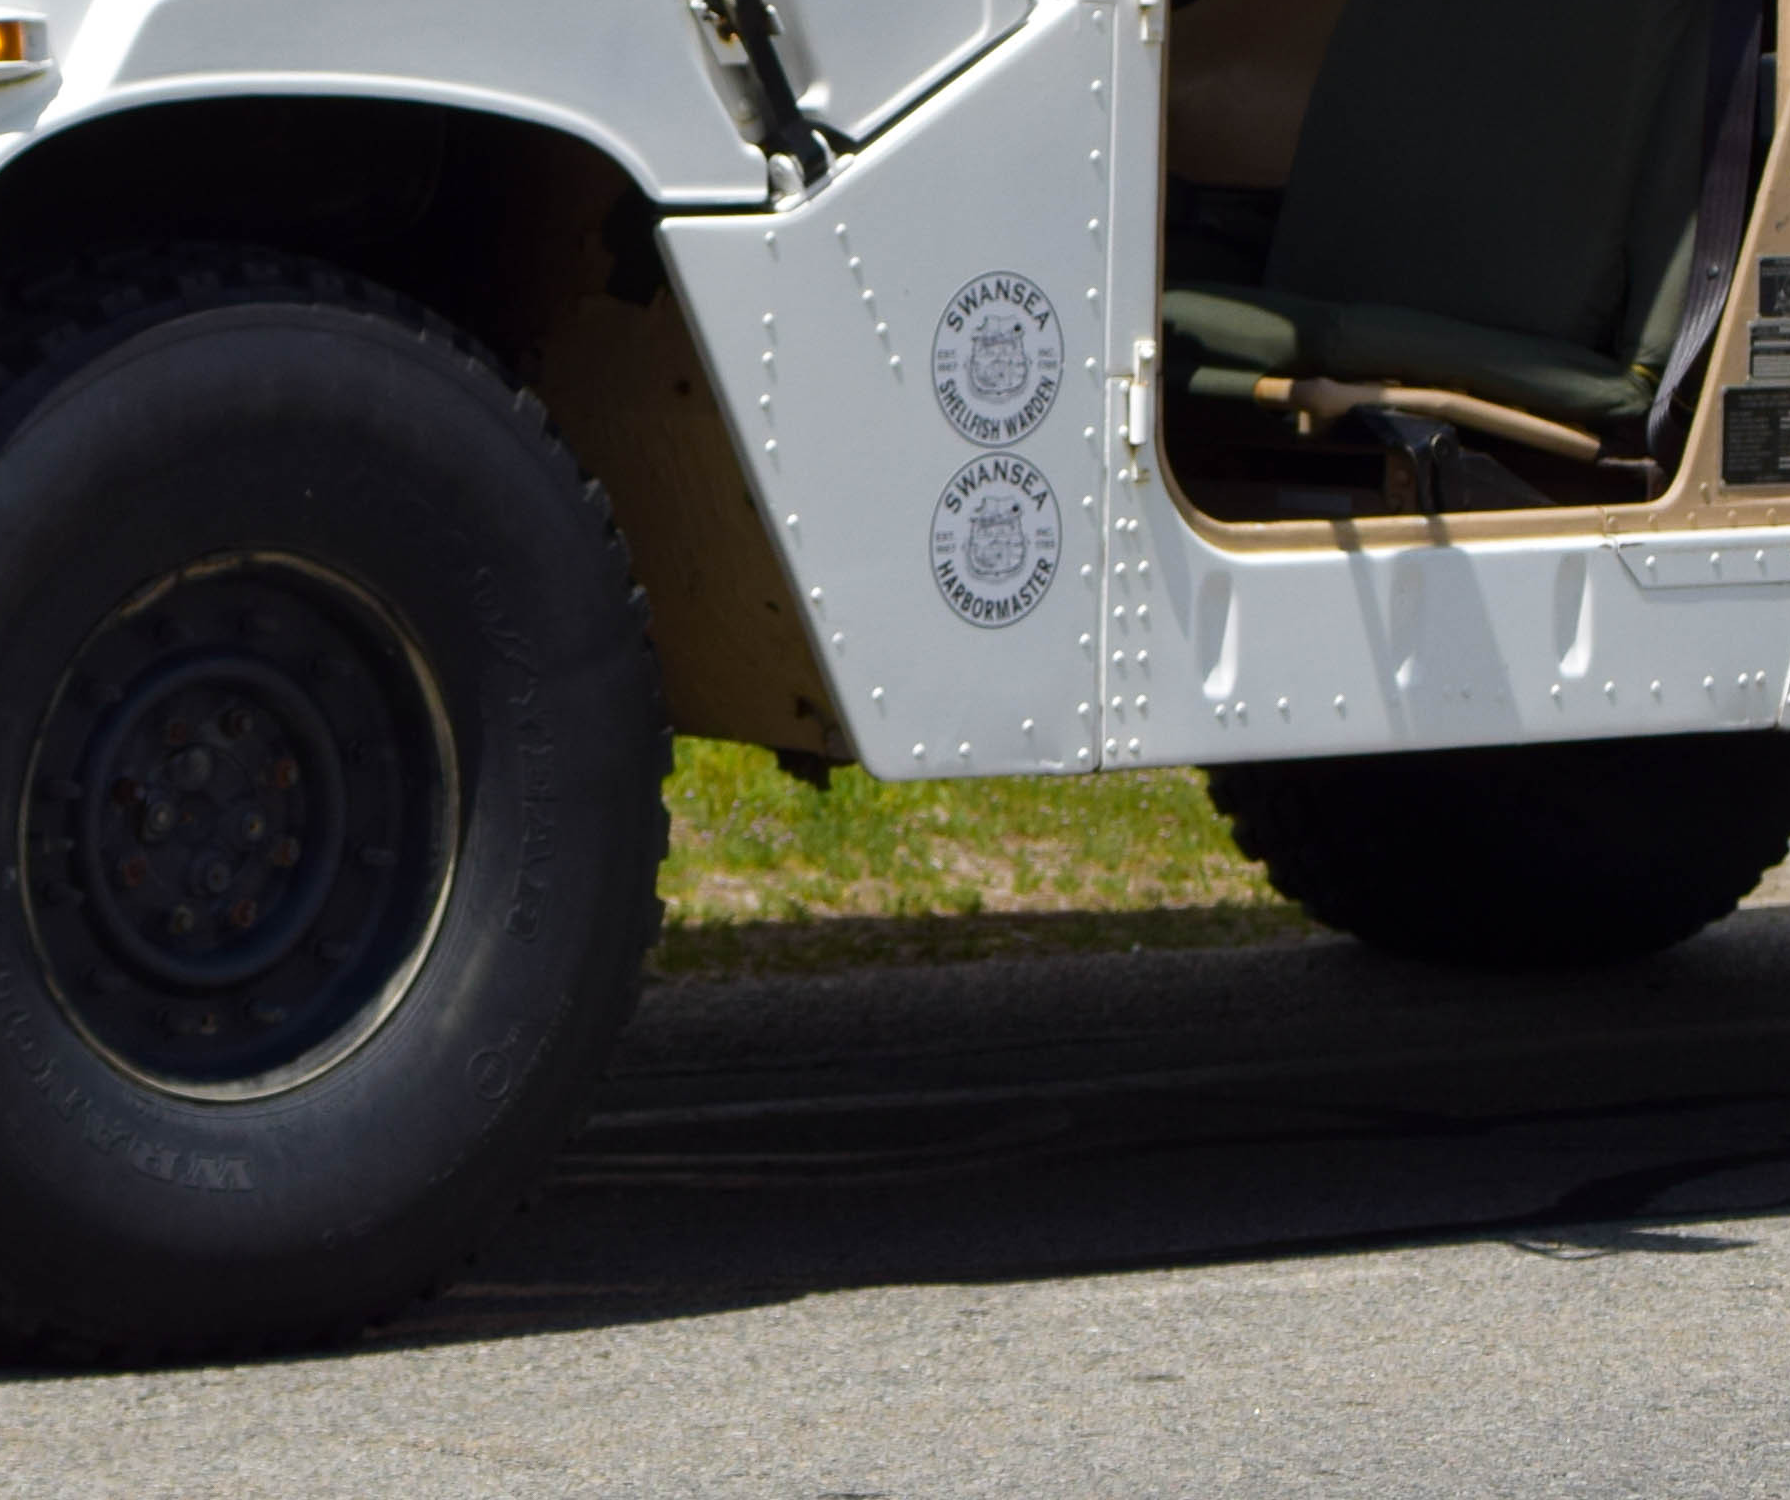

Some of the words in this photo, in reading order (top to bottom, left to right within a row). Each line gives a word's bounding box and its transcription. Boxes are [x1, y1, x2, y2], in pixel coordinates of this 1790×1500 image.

[946, 278, 1051, 333] SWANSEA
[939, 378, 1001, 440] SHELLFISH
[1004, 375, 1056, 437] WARDEN
[945, 459, 1049, 515] SWANSEA
[937, 558, 1055, 621] HARBORMASTER
